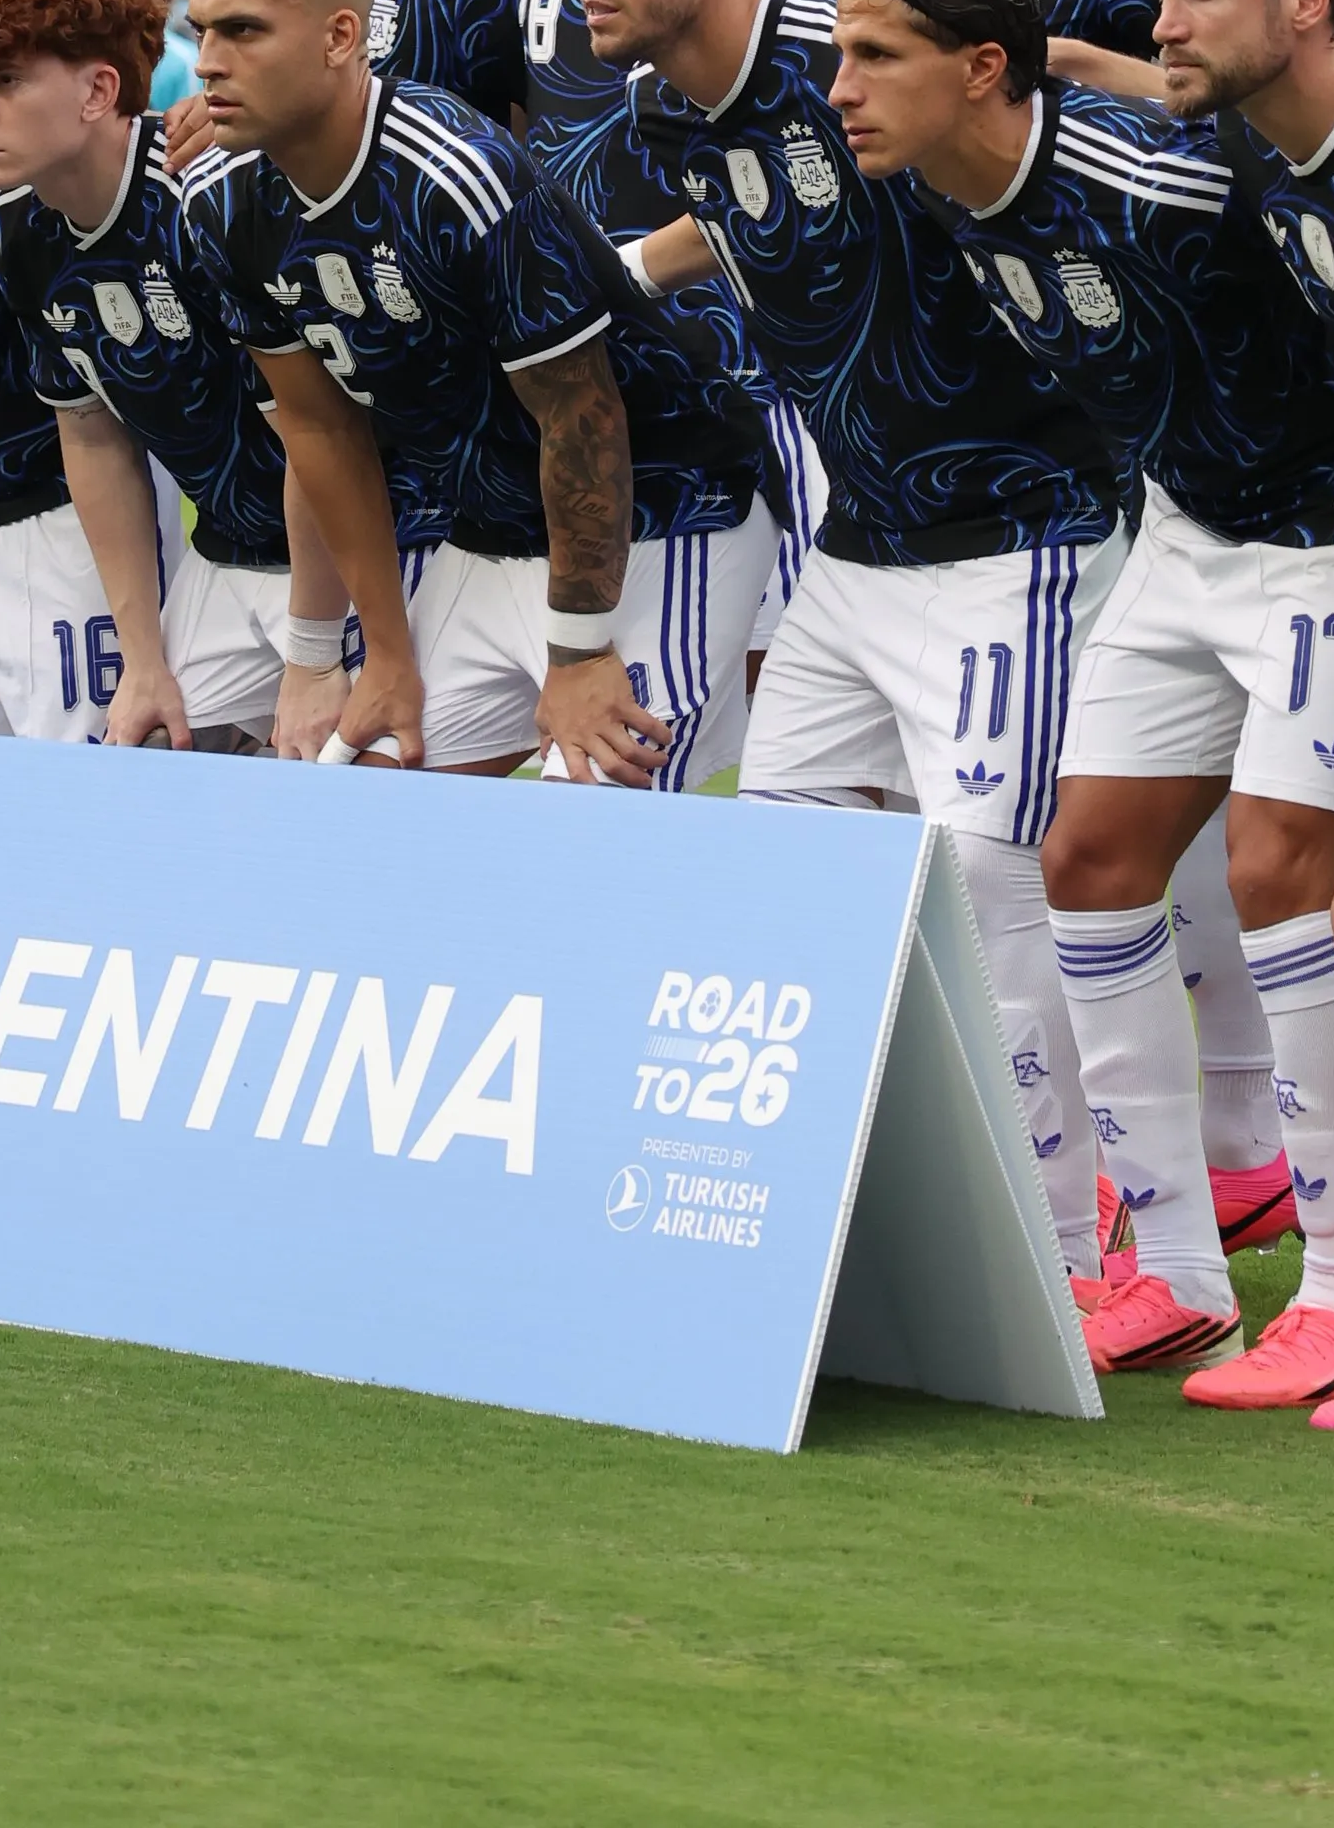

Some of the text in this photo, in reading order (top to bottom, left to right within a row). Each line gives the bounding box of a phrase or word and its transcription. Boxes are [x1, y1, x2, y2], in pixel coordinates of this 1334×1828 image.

[799, 158, 826, 189] AFA
[745, 193, 761, 202] FIFA
[340, 292, 359, 302] FIFA
[384, 282, 406, 308] AFA
[1074, 281, 1104, 309] AFA
[113, 321, 132, 331] FIFA
[156, 298, 180, 324] AFA
[53, 615, 125, 712] 16
[954, 642, 1015, 742] 11
[648, 971, 811, 1041] ROAD
[633, 1064, 690, 1115] TO
[641, 1137, 754, 1169] PRESENTED BY
[665, 1172, 769, 1214] TURKISH
[652, 1206, 763, 1248] AIRLINES
